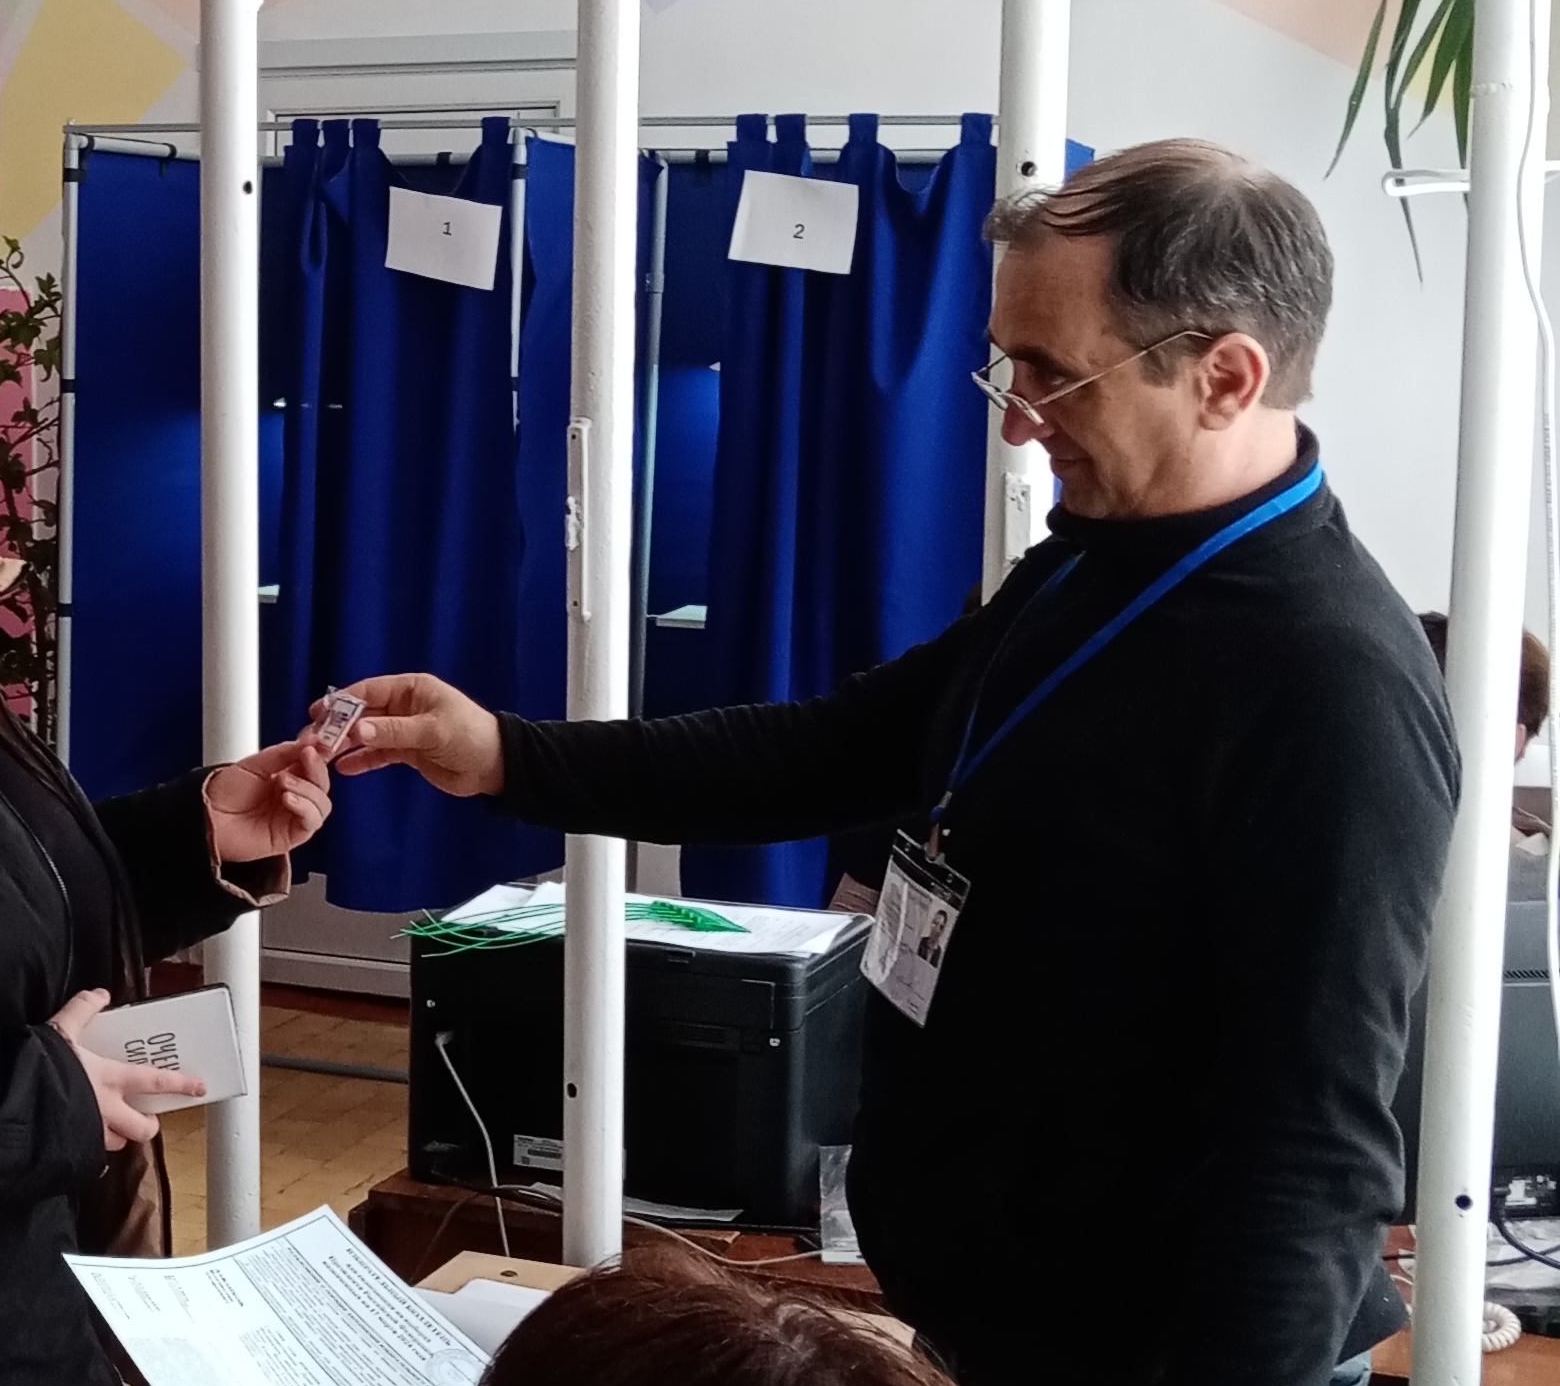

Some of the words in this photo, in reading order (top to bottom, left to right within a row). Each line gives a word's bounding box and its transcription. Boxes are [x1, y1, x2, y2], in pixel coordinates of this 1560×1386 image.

[442, 220, 453, 237] 1
[792, 223, 806, 241] 2
[395, 1334, 413, 1348] 2024
